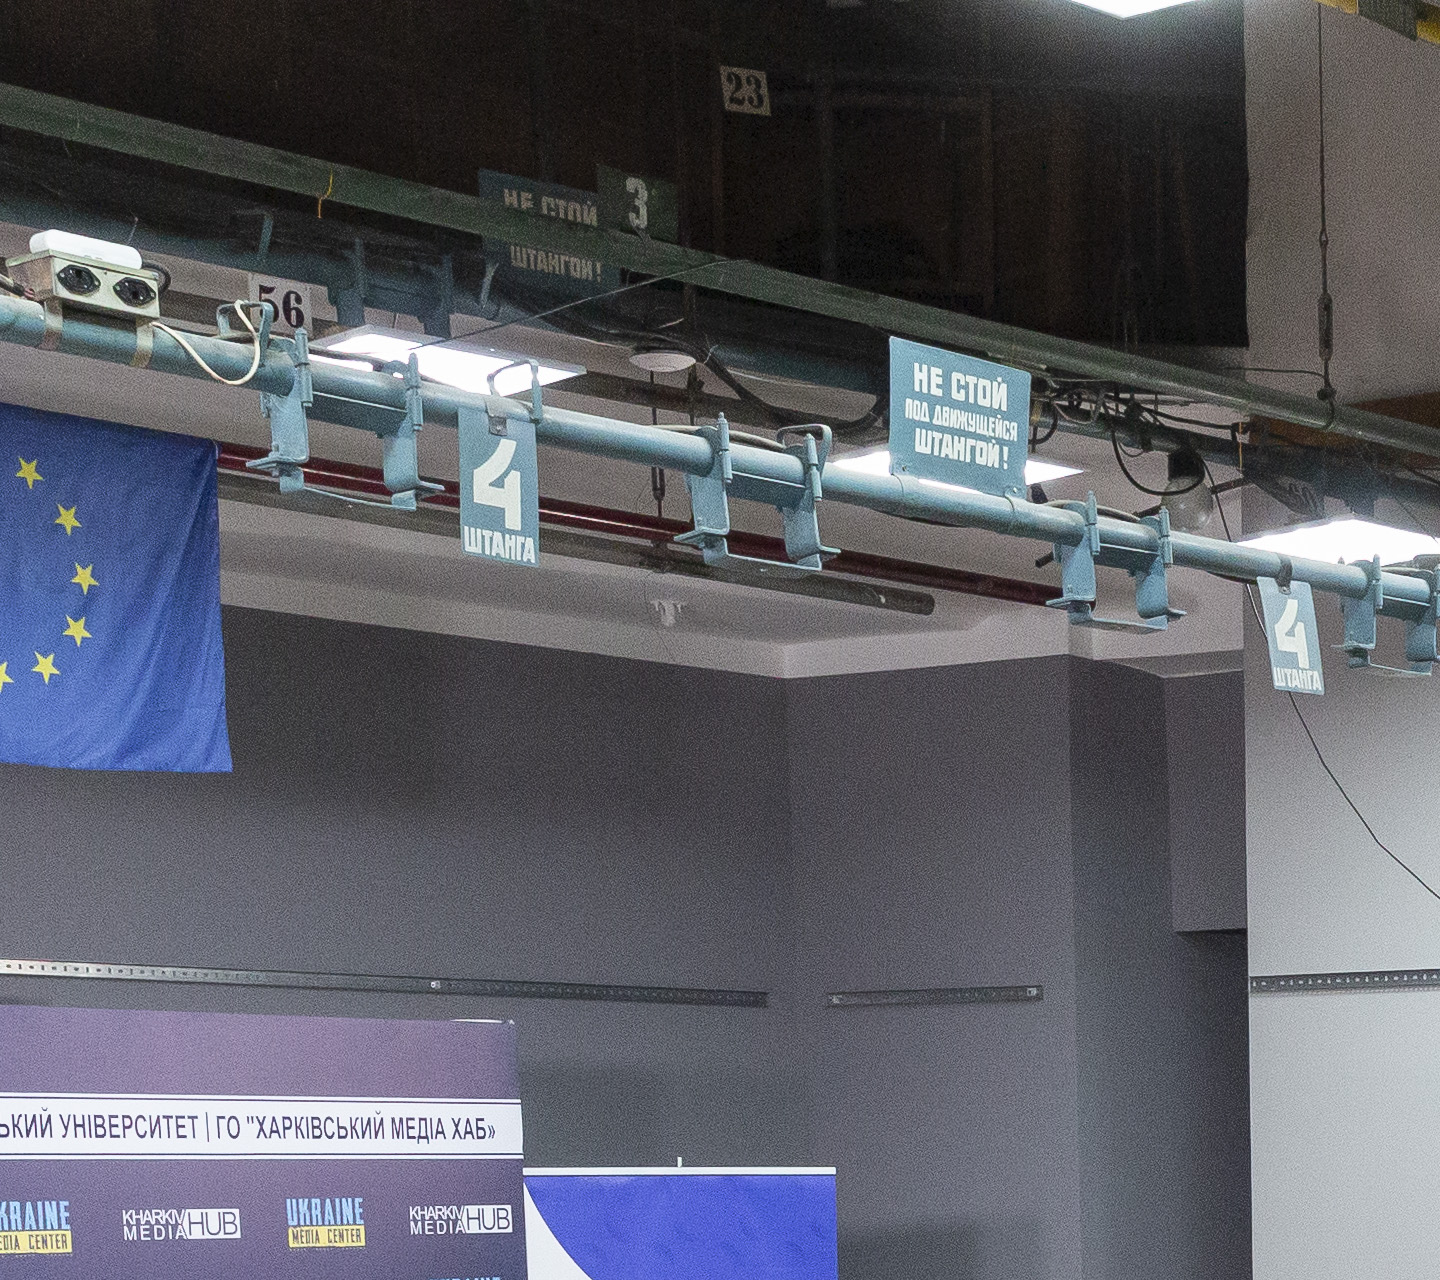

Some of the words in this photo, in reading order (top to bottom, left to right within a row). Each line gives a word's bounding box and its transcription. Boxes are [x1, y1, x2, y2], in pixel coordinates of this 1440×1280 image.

[726, 72, 764, 109] 23
[626, 177, 648, 229] 3
[259, 284, 304, 328] 56
[913, 362, 943, 397] НЕ
[951, 372, 1008, 411] СТОЙ
[905, 398, 930, 423] ПОД
[932, 405, 1018, 442] ДВИЖУЩЕЙСЯ
[473, 439, 521, 531] 4
[463, 526, 536, 563] ШТАНГА
[1274, 599, 1310, 669] 4
[1273, 666, 1322, 691] ШТАНГА
[61, 1113, 198, 1140] УНІВЕРСИТЕТ
[216, 1115, 241, 1140] ГО
[391, 1117, 447, 1145] МЕДІА
[122, 1209, 188, 1224] KHARKIV
[123, 1224, 188, 1240] MEDIA
[187, 1212, 239, 1236] HUB
[286, 1198, 365, 1226] UKRAINE
[409, 1205, 466, 1220] KHARKIV
[410, 1220, 466, 1235] MEDIA
[466, 1208, 511, 1231] HUB
[28, 1233, 69, 1249] CENTER
[292, 1229, 321, 1244] MEDIA
[328, 1228, 363, 1244] CENTER
